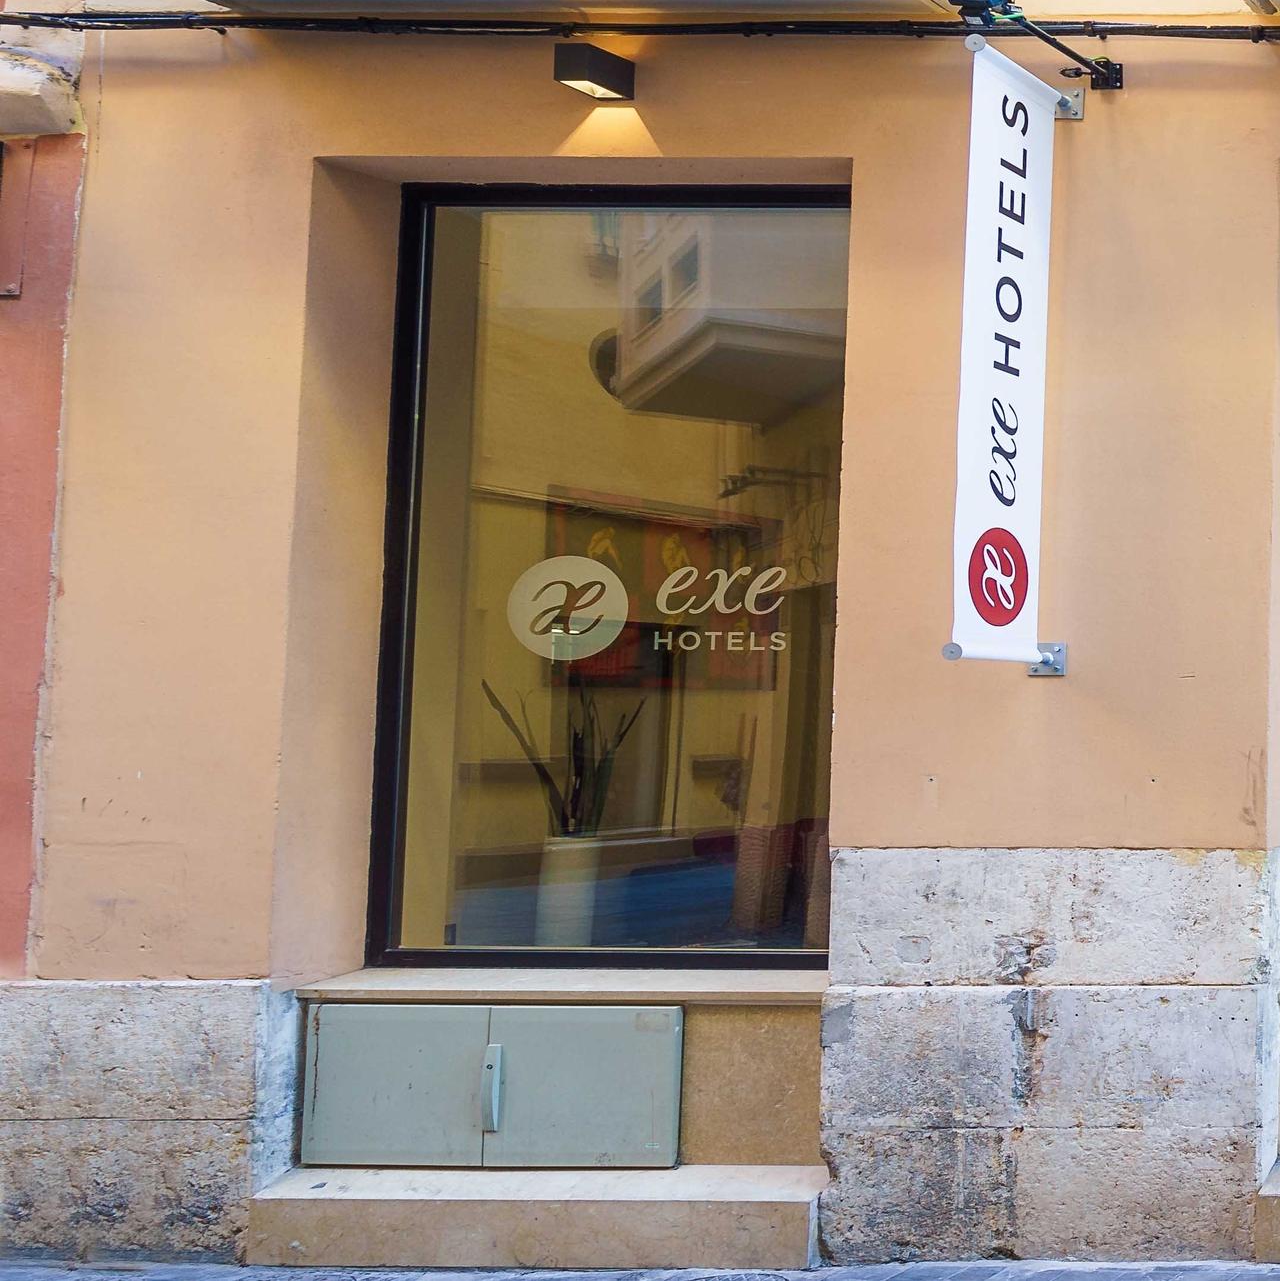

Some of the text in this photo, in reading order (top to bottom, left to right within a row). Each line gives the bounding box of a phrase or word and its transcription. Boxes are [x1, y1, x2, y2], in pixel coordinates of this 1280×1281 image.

[992, 93, 1029, 378] HOTELS
[989, 396, 1020, 508] exe
[655, 565, 788, 615] exe
[653, 630, 788, 652] HOTELS
